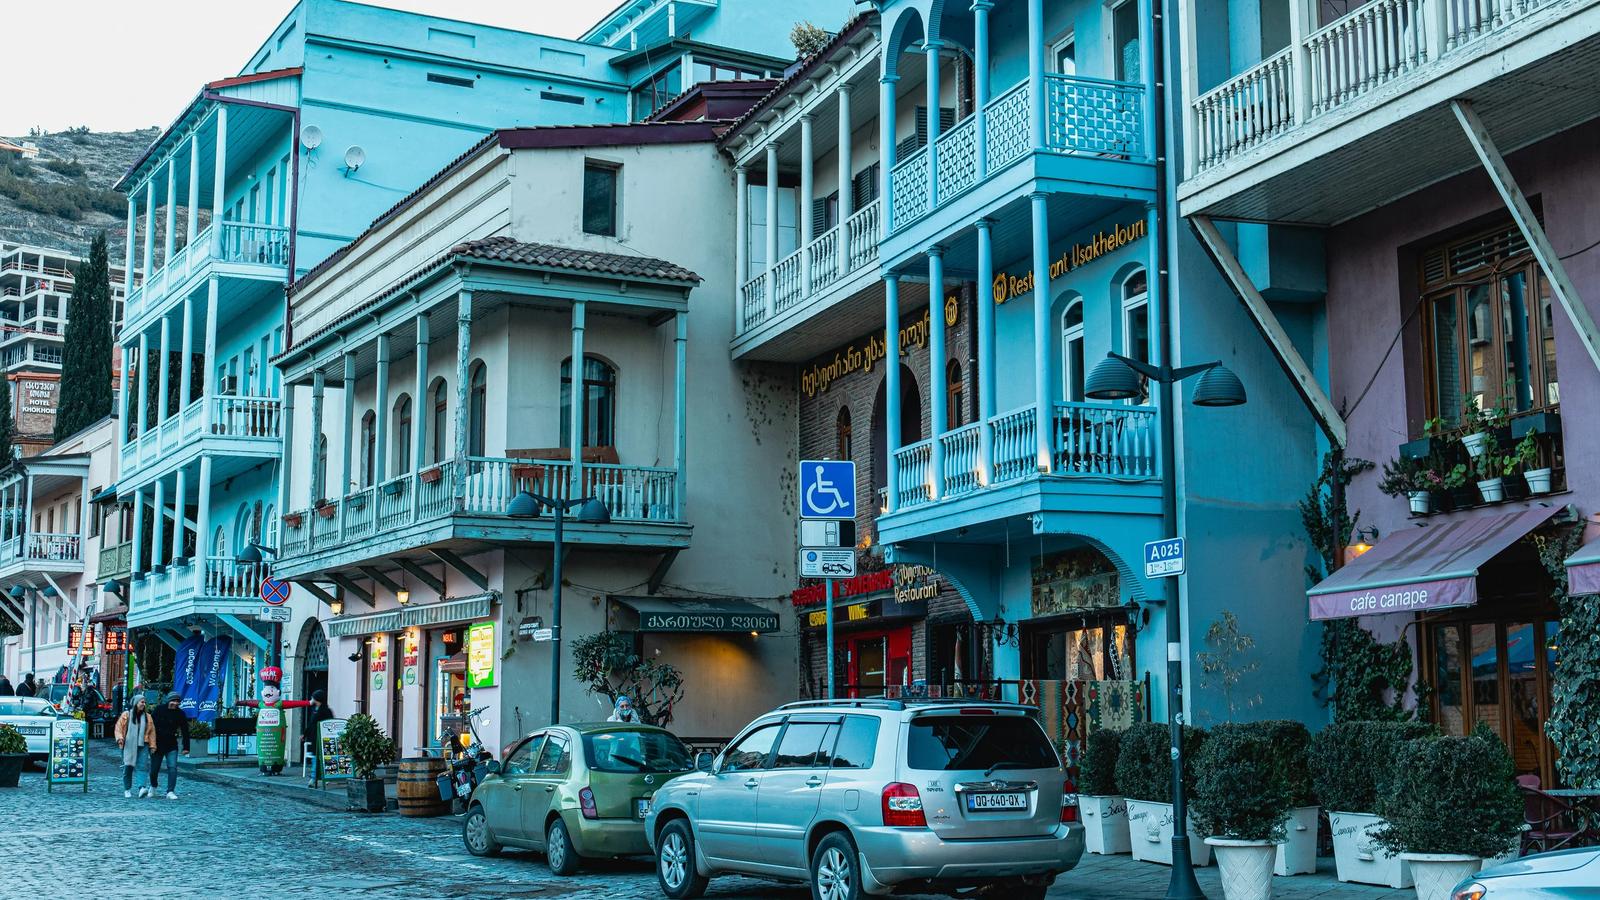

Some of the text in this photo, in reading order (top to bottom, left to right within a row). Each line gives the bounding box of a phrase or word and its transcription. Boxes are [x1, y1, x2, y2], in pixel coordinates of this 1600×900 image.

[1150, 542, 1181, 561] A025
[894, 582, 938, 605] Restaurant
[1350, 590, 1428, 611] cafe canape
[647, 615, 778, 629] ქართული ღვინო
[208, 649, 221, 687] Welcome
